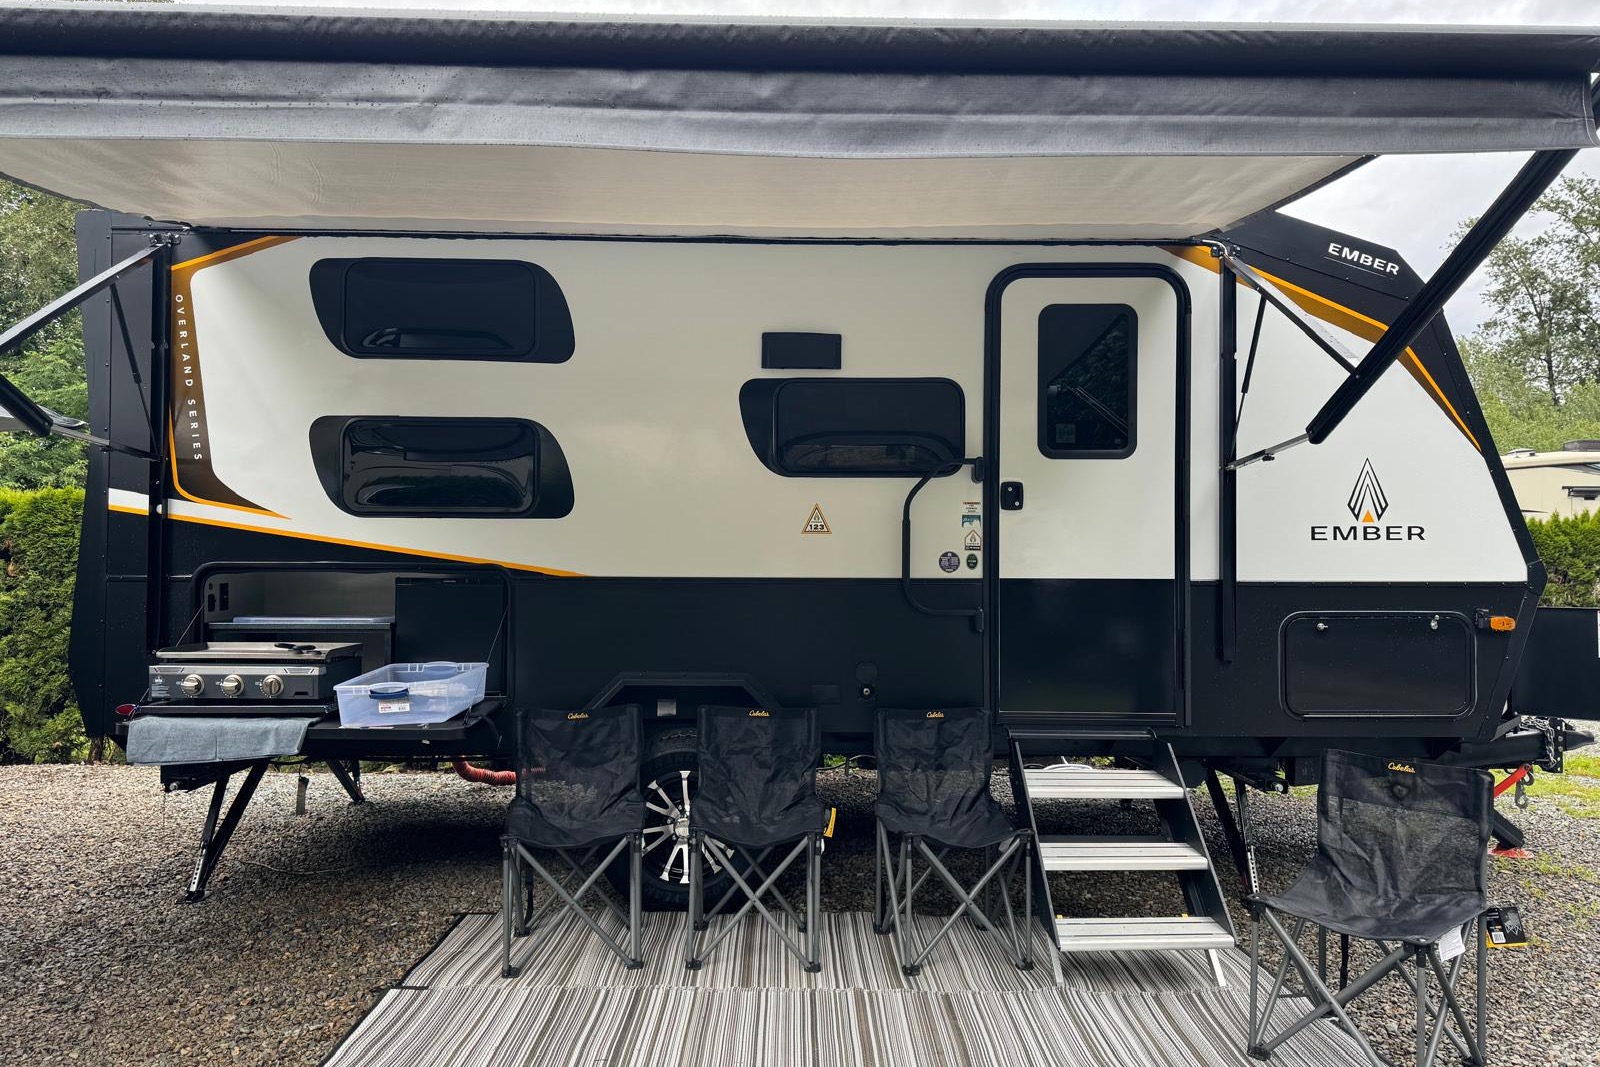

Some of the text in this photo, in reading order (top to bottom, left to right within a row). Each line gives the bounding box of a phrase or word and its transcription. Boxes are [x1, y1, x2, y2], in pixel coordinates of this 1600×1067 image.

[1328, 242, 1400, 276] EMBER
[175, 294, 203, 460] OVERLAND SERIES
[1310, 526, 1426, 541] EMBER
